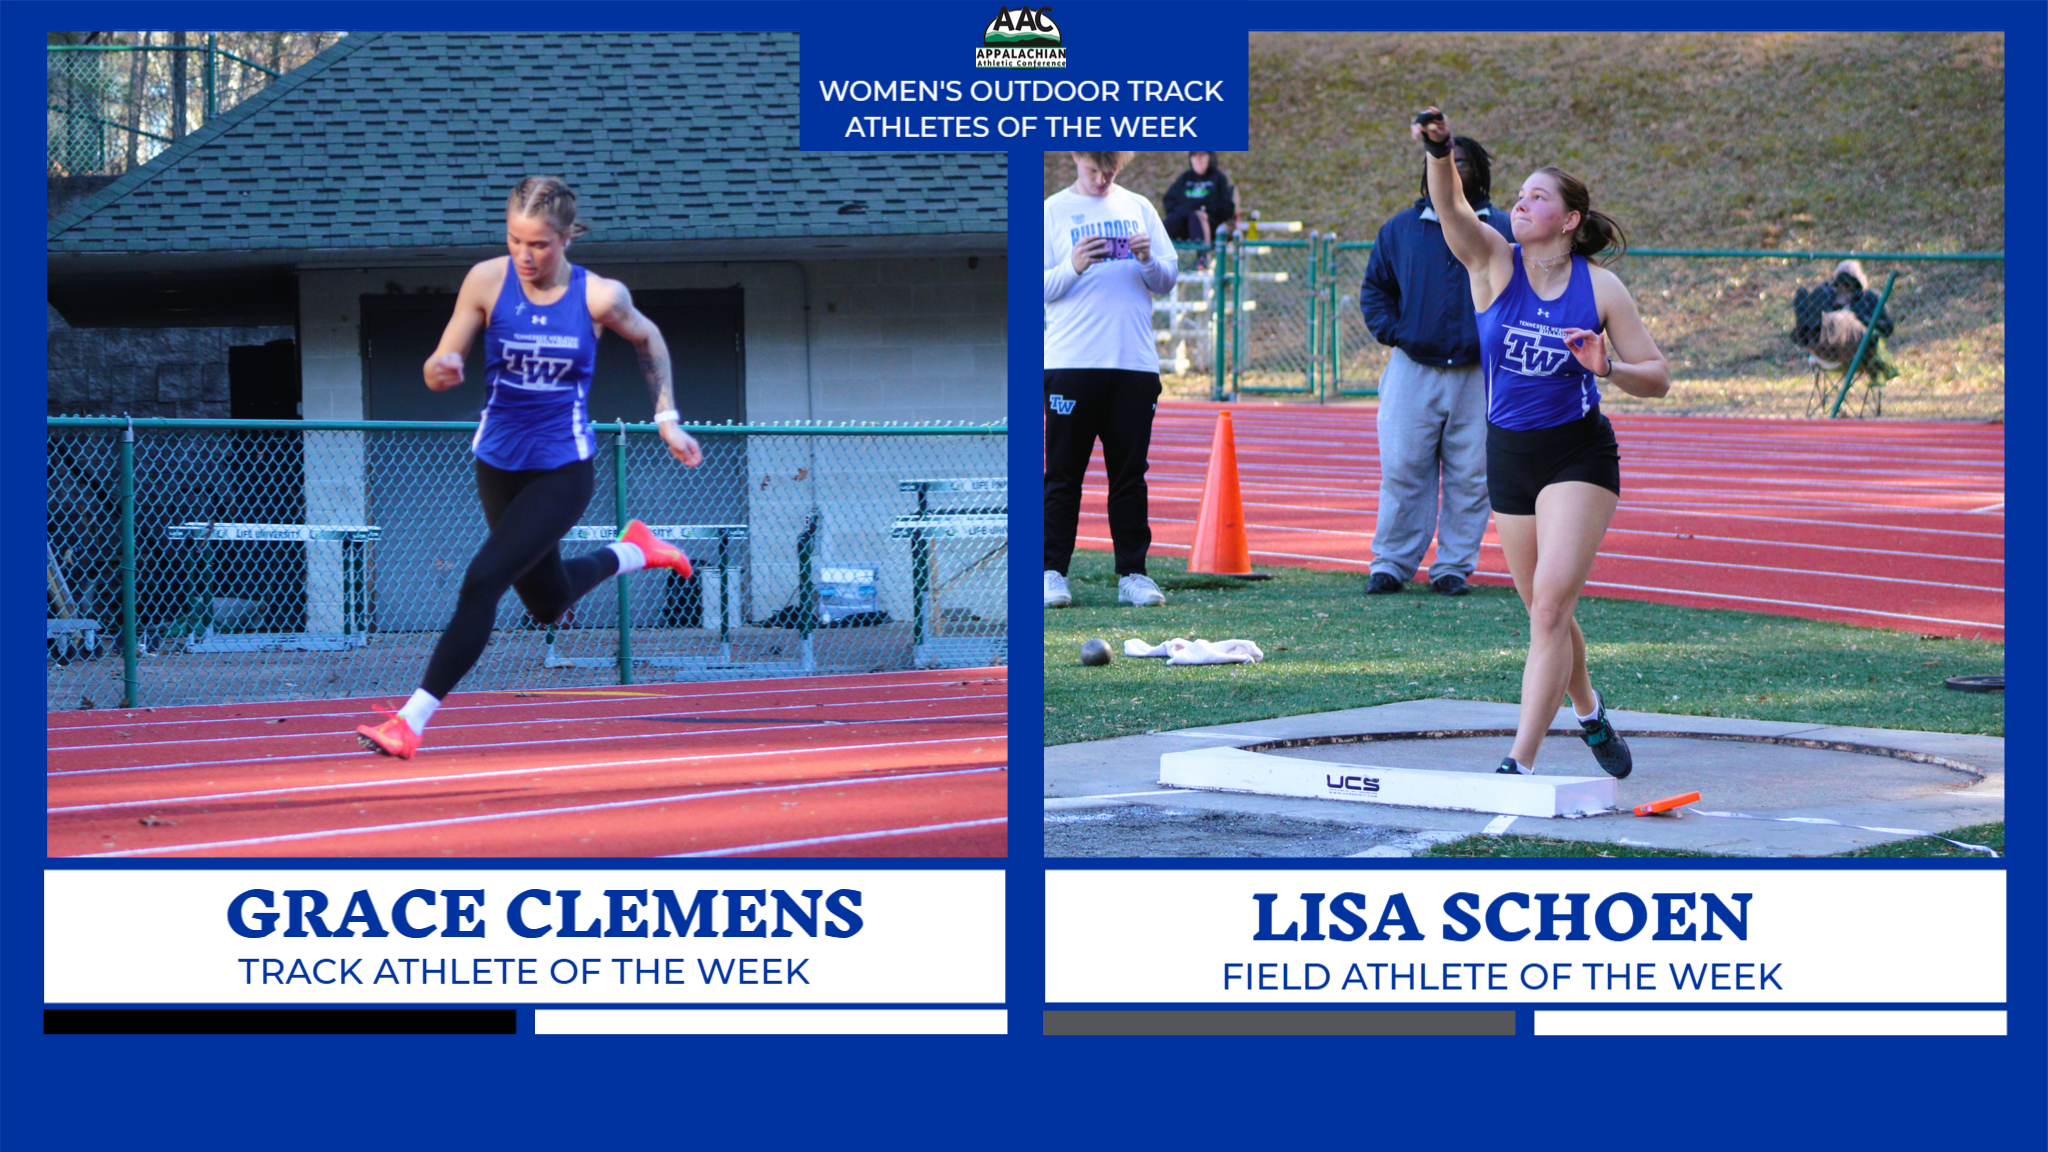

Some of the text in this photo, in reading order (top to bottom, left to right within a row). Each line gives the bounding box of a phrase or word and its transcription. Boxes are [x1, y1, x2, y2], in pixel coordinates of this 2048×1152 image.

[1503, 329, 1570, 375] TW
[503, 343, 573, 388] TW
[1049, 393, 1077, 415] TW
[254, 530, 300, 540] UNIVERSITY
[1327, 774, 1380, 792] UCS
